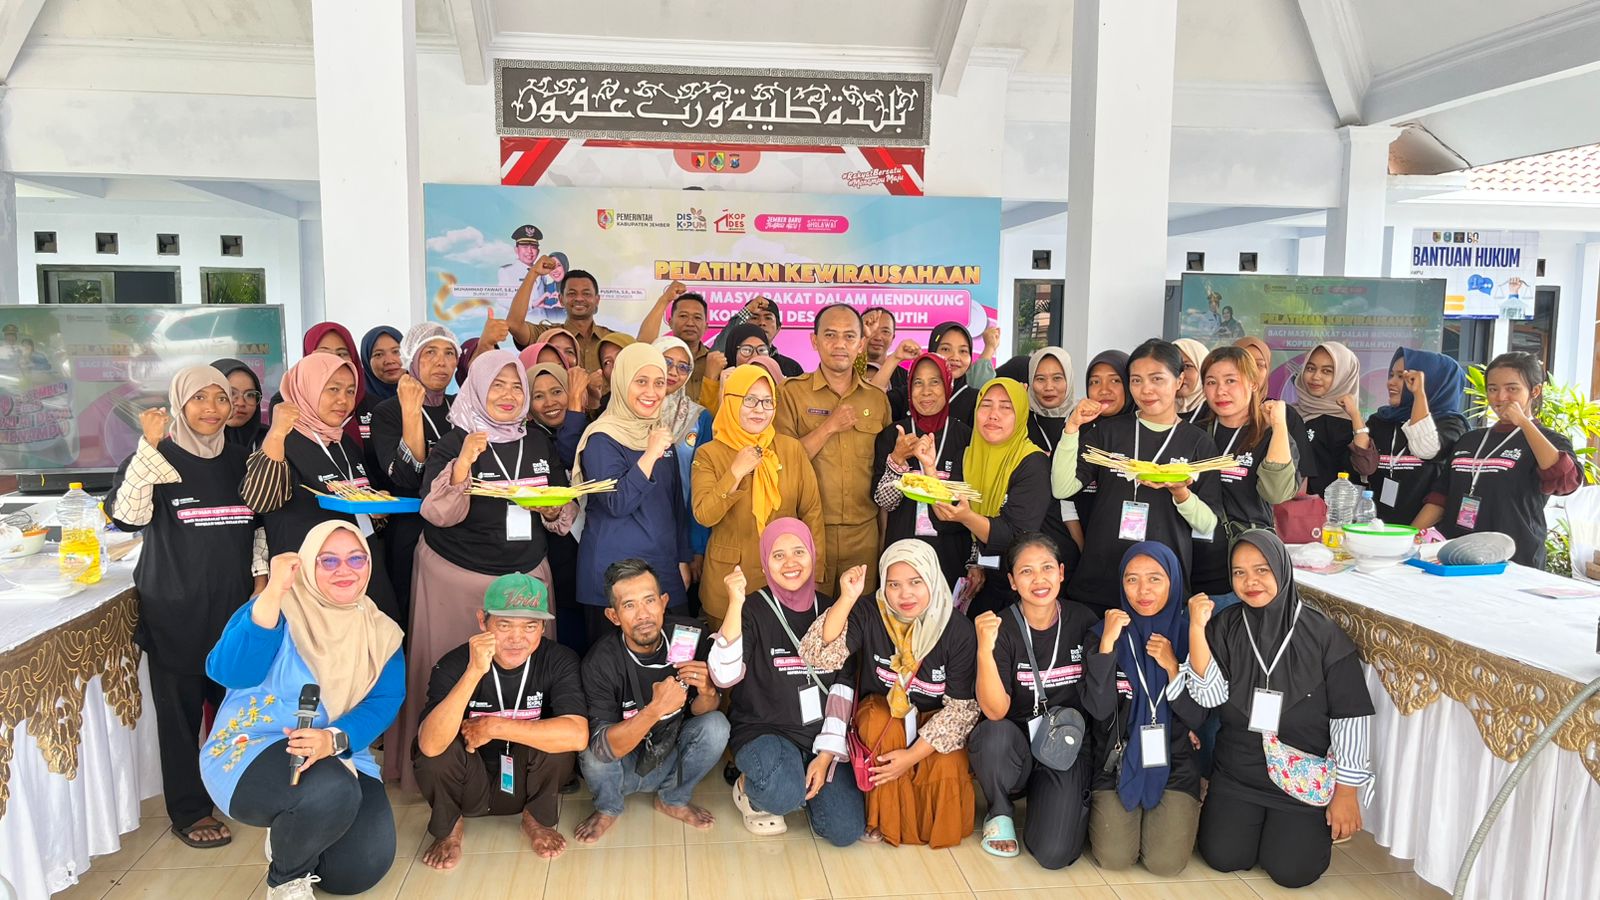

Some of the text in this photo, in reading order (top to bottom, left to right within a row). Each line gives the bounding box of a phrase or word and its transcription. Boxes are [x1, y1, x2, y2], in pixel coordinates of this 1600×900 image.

[616, 213, 653, 221] PEMERINTAH
[1413, 246, 1521, 268] BANTUAN HUKUM
[654, 260, 981, 284] PELATIHAN KEWIRAUSAHAAN
[815, 293, 867, 305] DALAM
[871, 293, 964, 306] MENDUKUNG
[786, 310, 815, 322] DES
[891, 311, 928, 323] UTIH
